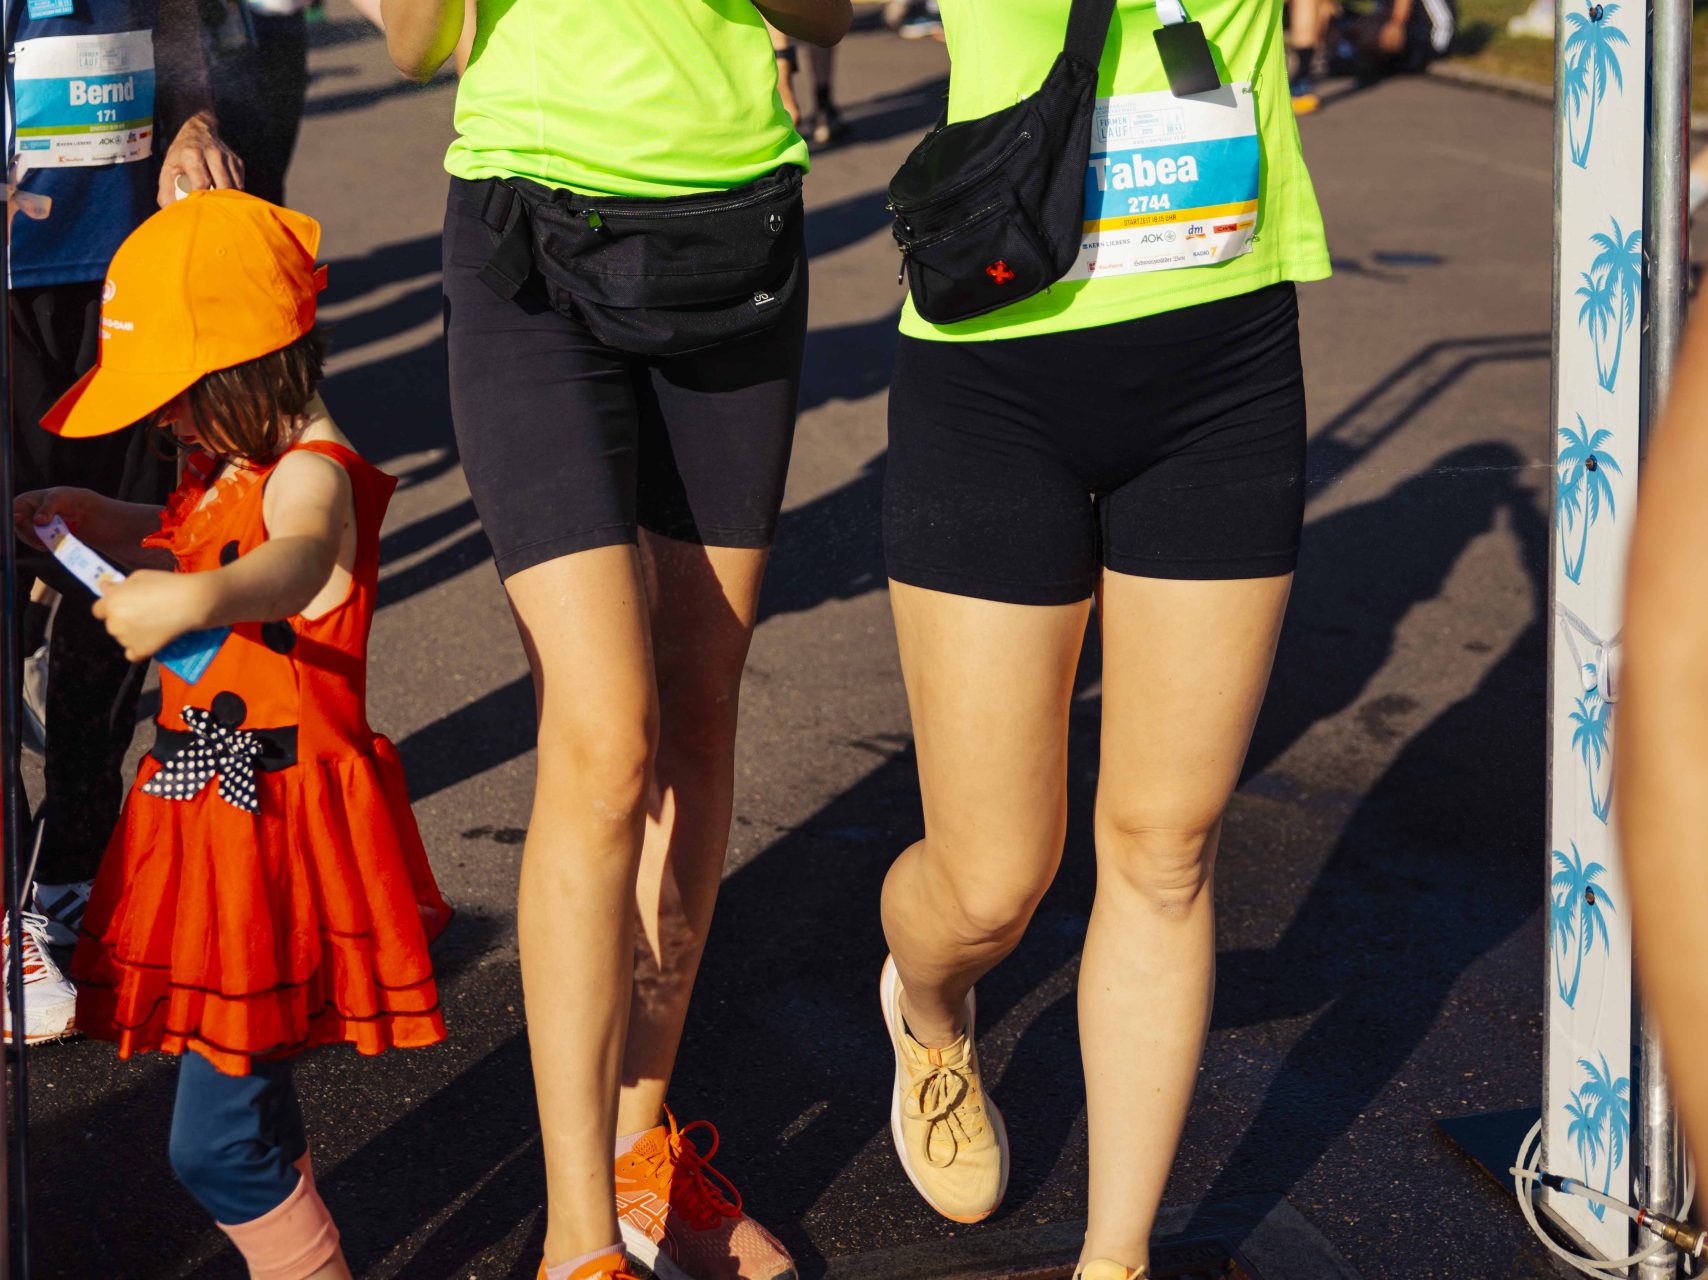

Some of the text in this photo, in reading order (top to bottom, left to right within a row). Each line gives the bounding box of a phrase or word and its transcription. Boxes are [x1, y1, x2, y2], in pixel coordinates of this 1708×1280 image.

[69, 76, 134, 107] Bernd
[96, 109, 117, 123] 171
[1100, 117, 1127, 127] FIRMEN
[1101, 125, 1129, 138] LAUF
[1088, 152, 1198, 192] Tabea
[1127, 193, 1171, 214] 2744
[1188, 224, 1203, 235] dm
[1140, 233, 1164, 244] AOK
[1209, 245, 1217, 257] 7
